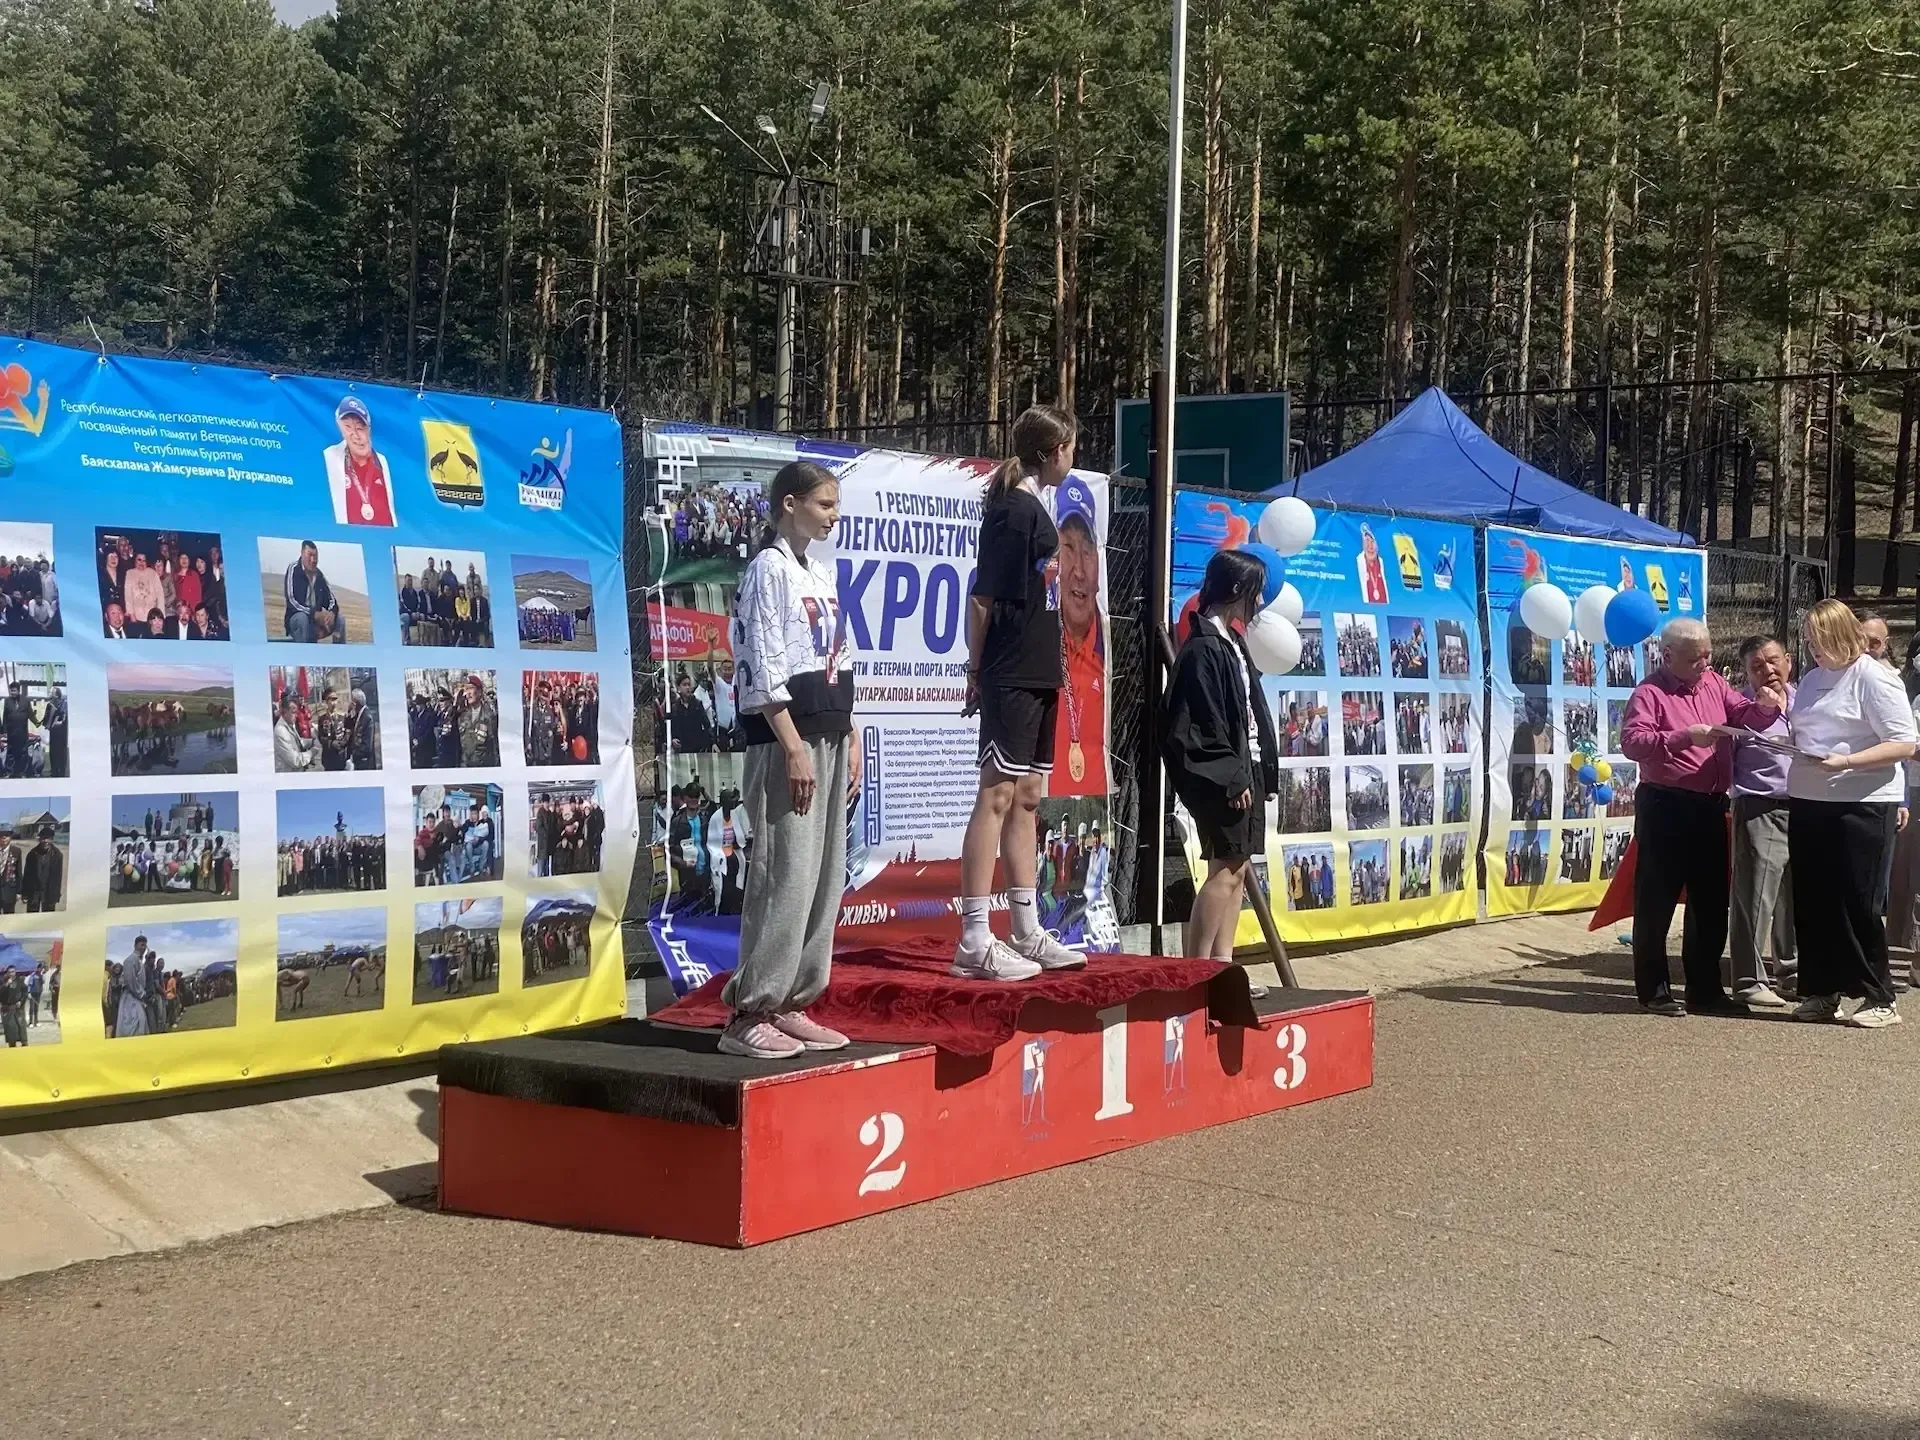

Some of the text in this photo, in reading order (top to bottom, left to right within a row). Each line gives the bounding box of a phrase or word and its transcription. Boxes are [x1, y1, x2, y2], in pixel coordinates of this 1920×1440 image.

[60, 398, 157, 420] Республиканский
[159, 412, 259, 429] легкоатлетический
[79, 420, 281, 450] посвящённый памяти Ветерана спорта
[133, 441, 243, 462] Республики Бурятия
[81, 454, 293, 485] Баясхалана Жамсуевича Дугаржапова
[875, 490, 883, 512] 1
[836, 515, 981, 559] ЛЕГКОАТЛЕТИЧ
[873, 661, 912, 677] ВЕТЕРАНА
[914, 662, 943, 677] СПОРТА
[945, 663, 967, 678] РЕСП
[916, 687, 965, 702] БАЯСХАЛАНА
[839, 900, 888, 926] ЖИВЁМ
[1095, 1003, 1134, 1121] 1
[1273, 1023, 1307, 1090] 3
[859, 1111, 907, 1197] 2
